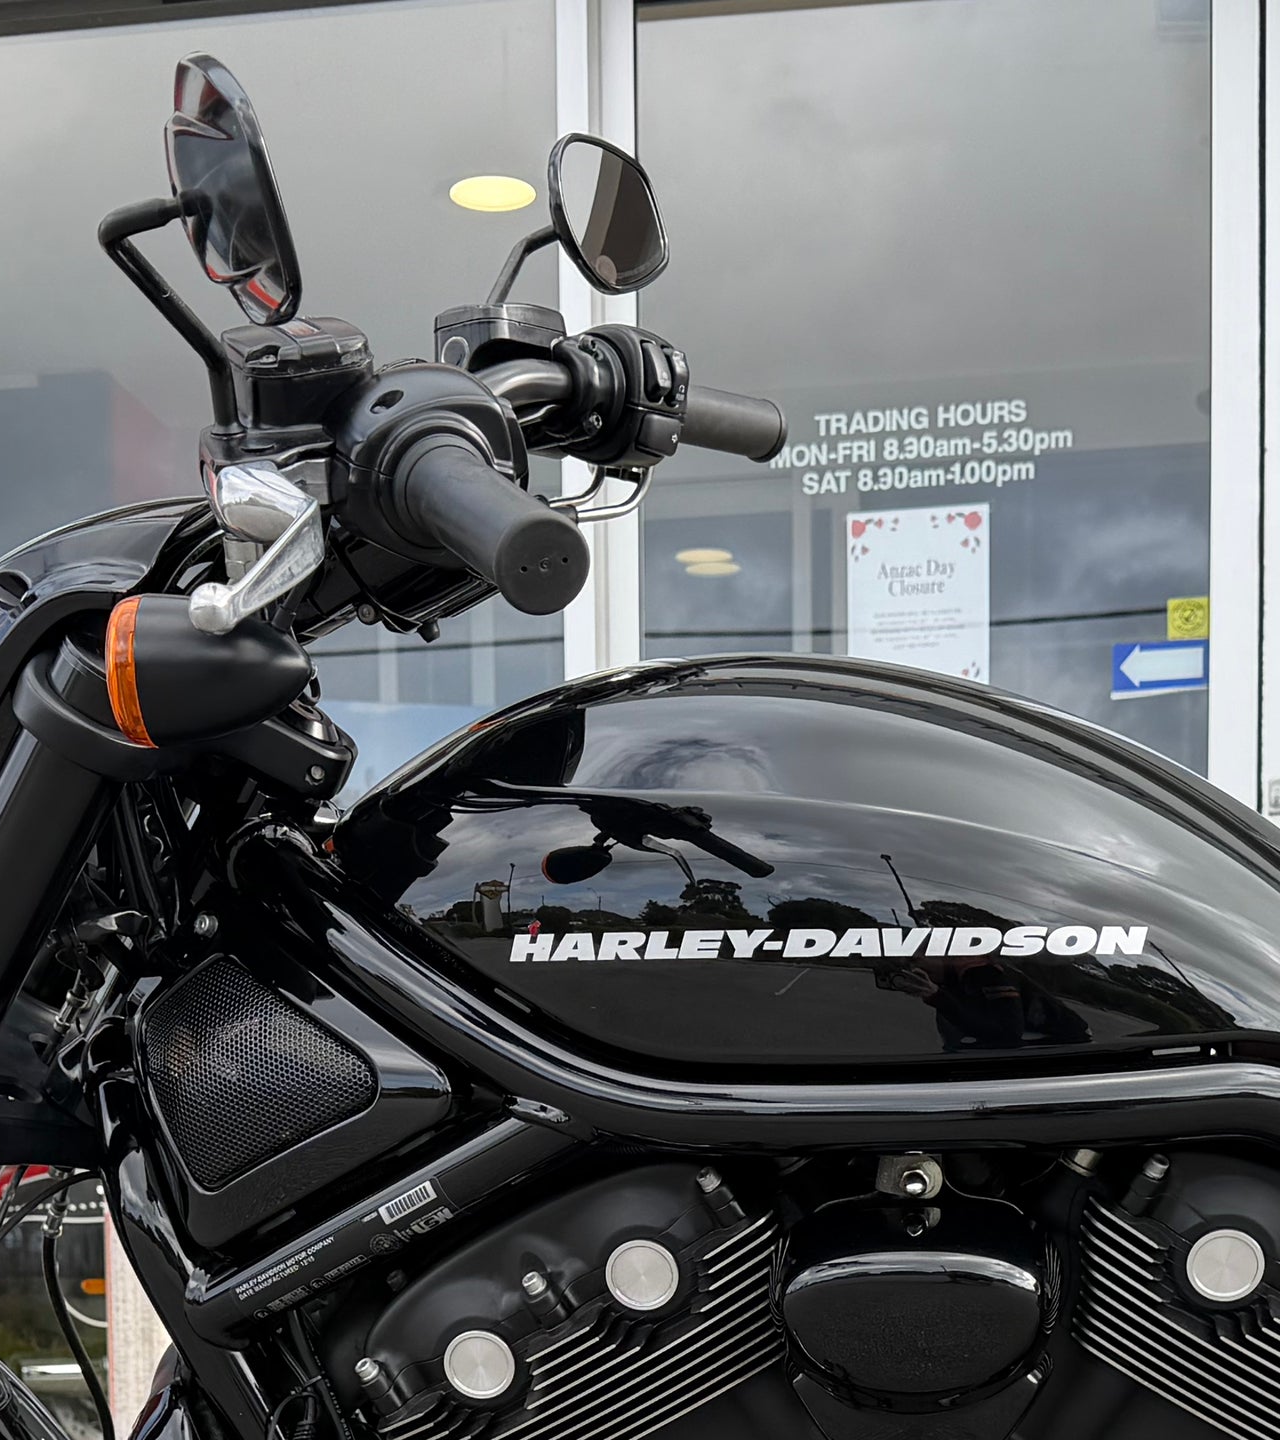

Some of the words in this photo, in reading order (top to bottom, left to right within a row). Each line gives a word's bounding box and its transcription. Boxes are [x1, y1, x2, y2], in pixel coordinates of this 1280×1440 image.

[814, 406, 929, 436] TRADING
[937, 400, 1027, 428] HOURS
[770, 440, 876, 469] MON-FRI
[883, 428, 1073, 460] 8.30am-5.30pm
[802, 471, 851, 495] SAT
[857, 460, 1035, 492] 8.30am-1.00pm
[926, 558, 955, 578] Day
[888, 579, 945, 597] Closure
[509, 926, 1149, 963] HARLEY-DAVIDSON
